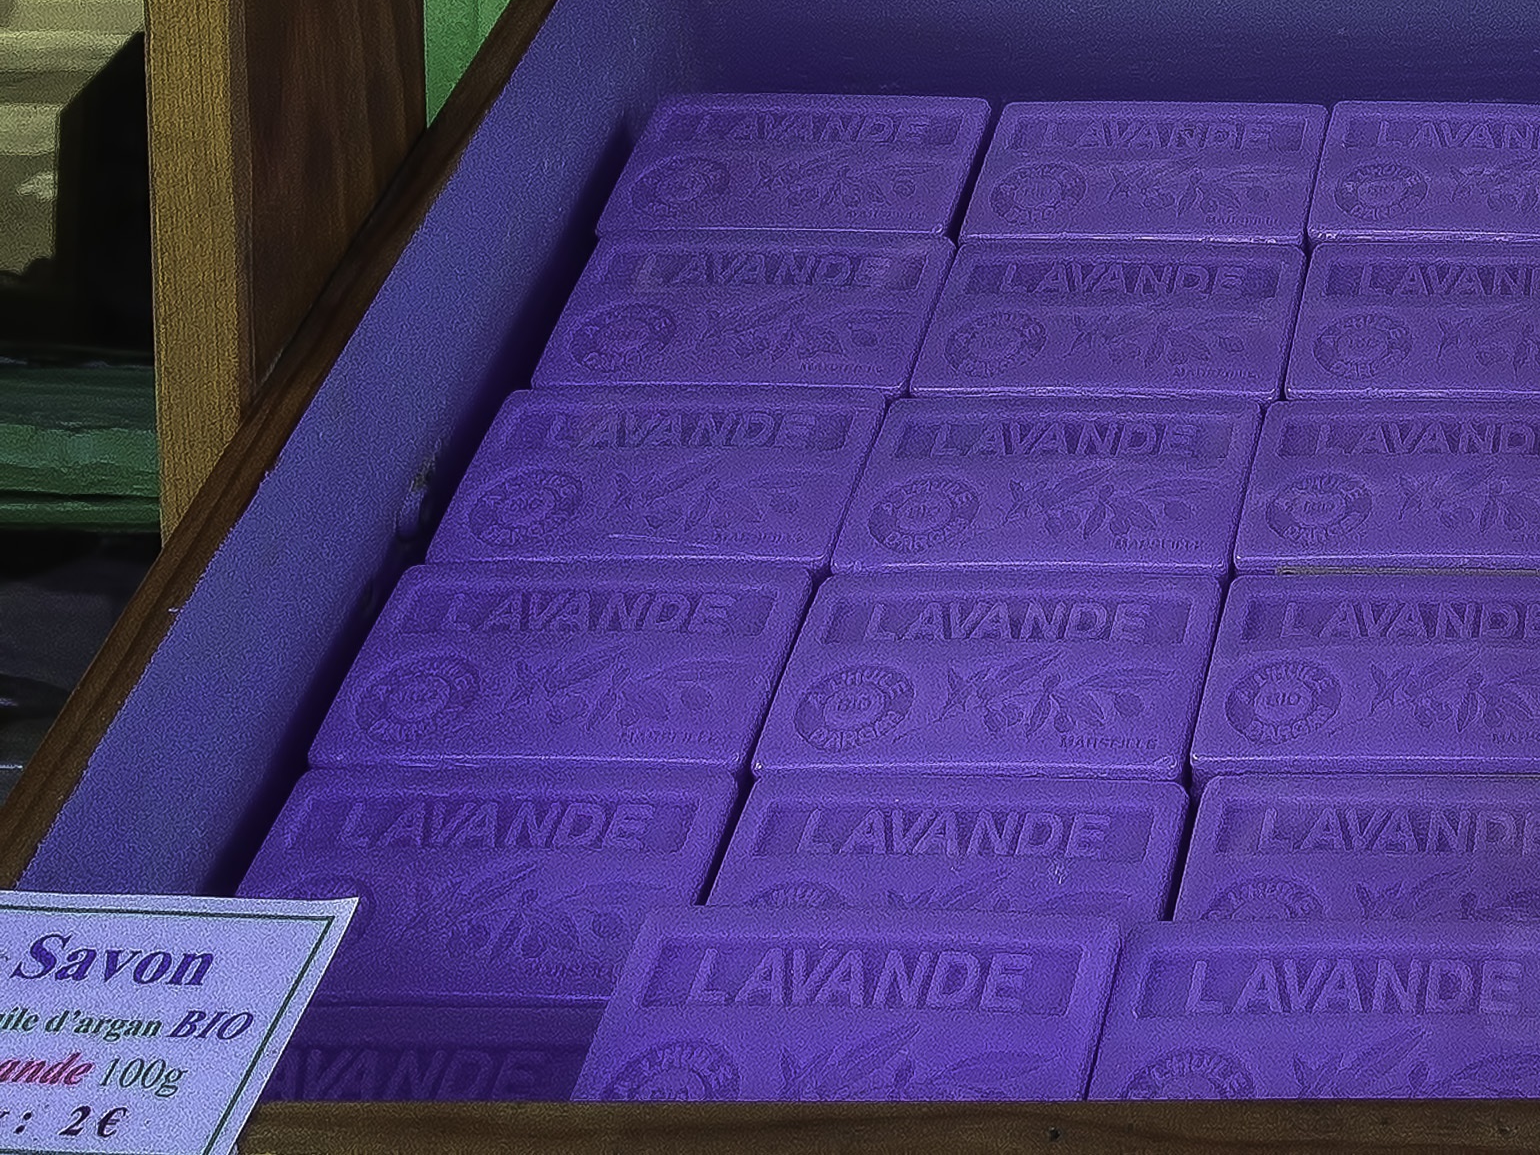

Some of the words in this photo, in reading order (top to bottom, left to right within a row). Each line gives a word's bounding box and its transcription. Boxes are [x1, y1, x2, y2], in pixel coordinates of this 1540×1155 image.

[928, 420, 1198, 457] LAVANDE
[862, 600, 1152, 643] LAVANDE
[335, 800, 656, 849] LAVANDE
[799, 806, 1112, 857] LAVANDE
[10, 933, 216, 987] Savon
[685, 944, 1034, 1013] LAVANDE
[1184, 957, 1525, 1018] LAVANDE
[44, 1009, 164, 1043] d'argan
[166, 1009, 255, 1041] BIO
[99, 1056, 190, 1098] 100g
